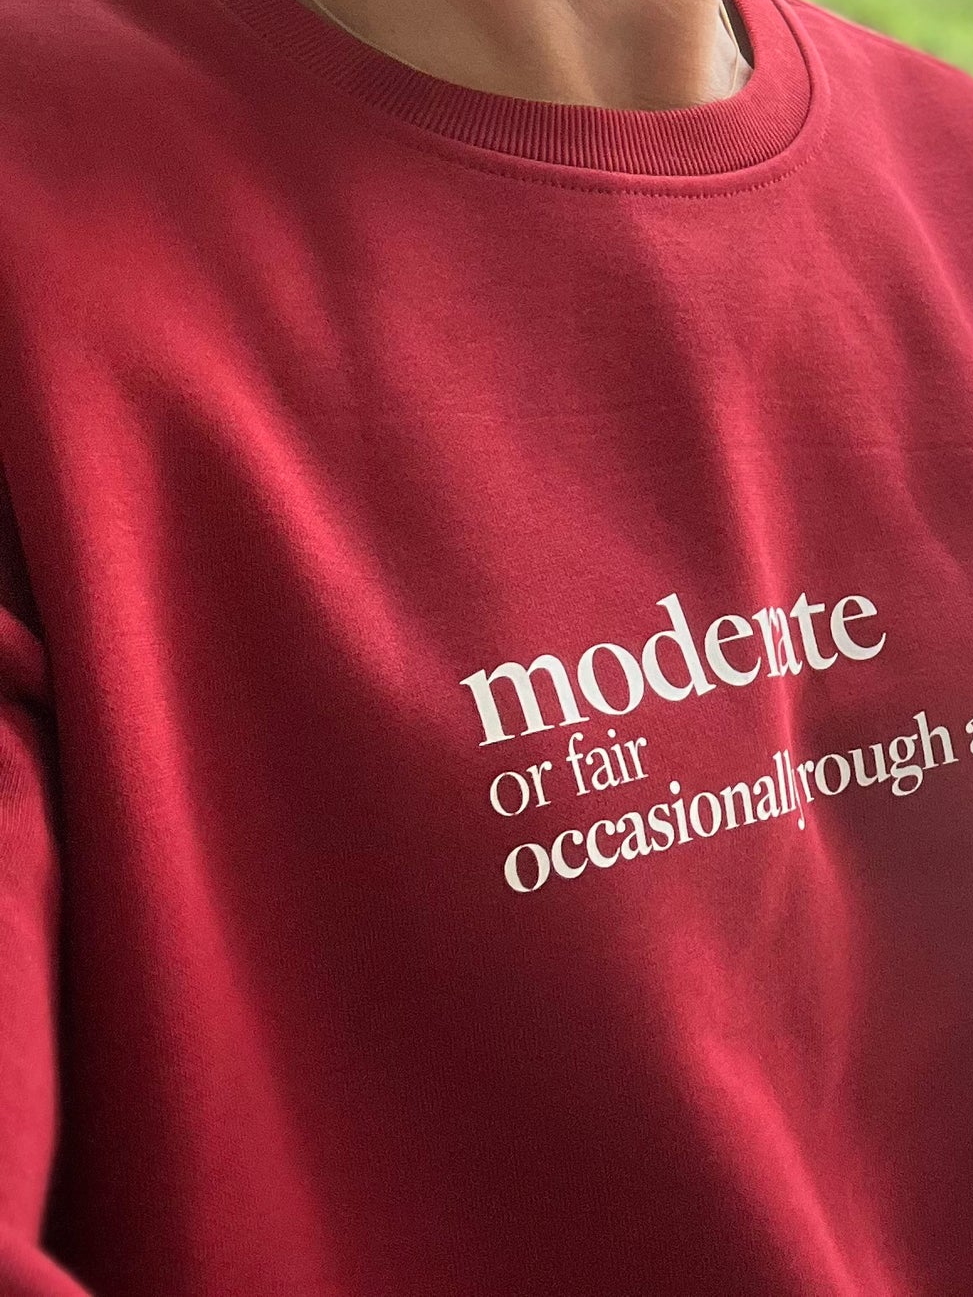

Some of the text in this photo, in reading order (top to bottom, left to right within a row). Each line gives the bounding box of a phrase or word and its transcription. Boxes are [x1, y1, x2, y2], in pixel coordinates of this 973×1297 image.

[459, 593, 887, 747] moderate
[489, 728, 649, 817] or fair
[796, 711, 959, 797] rough
